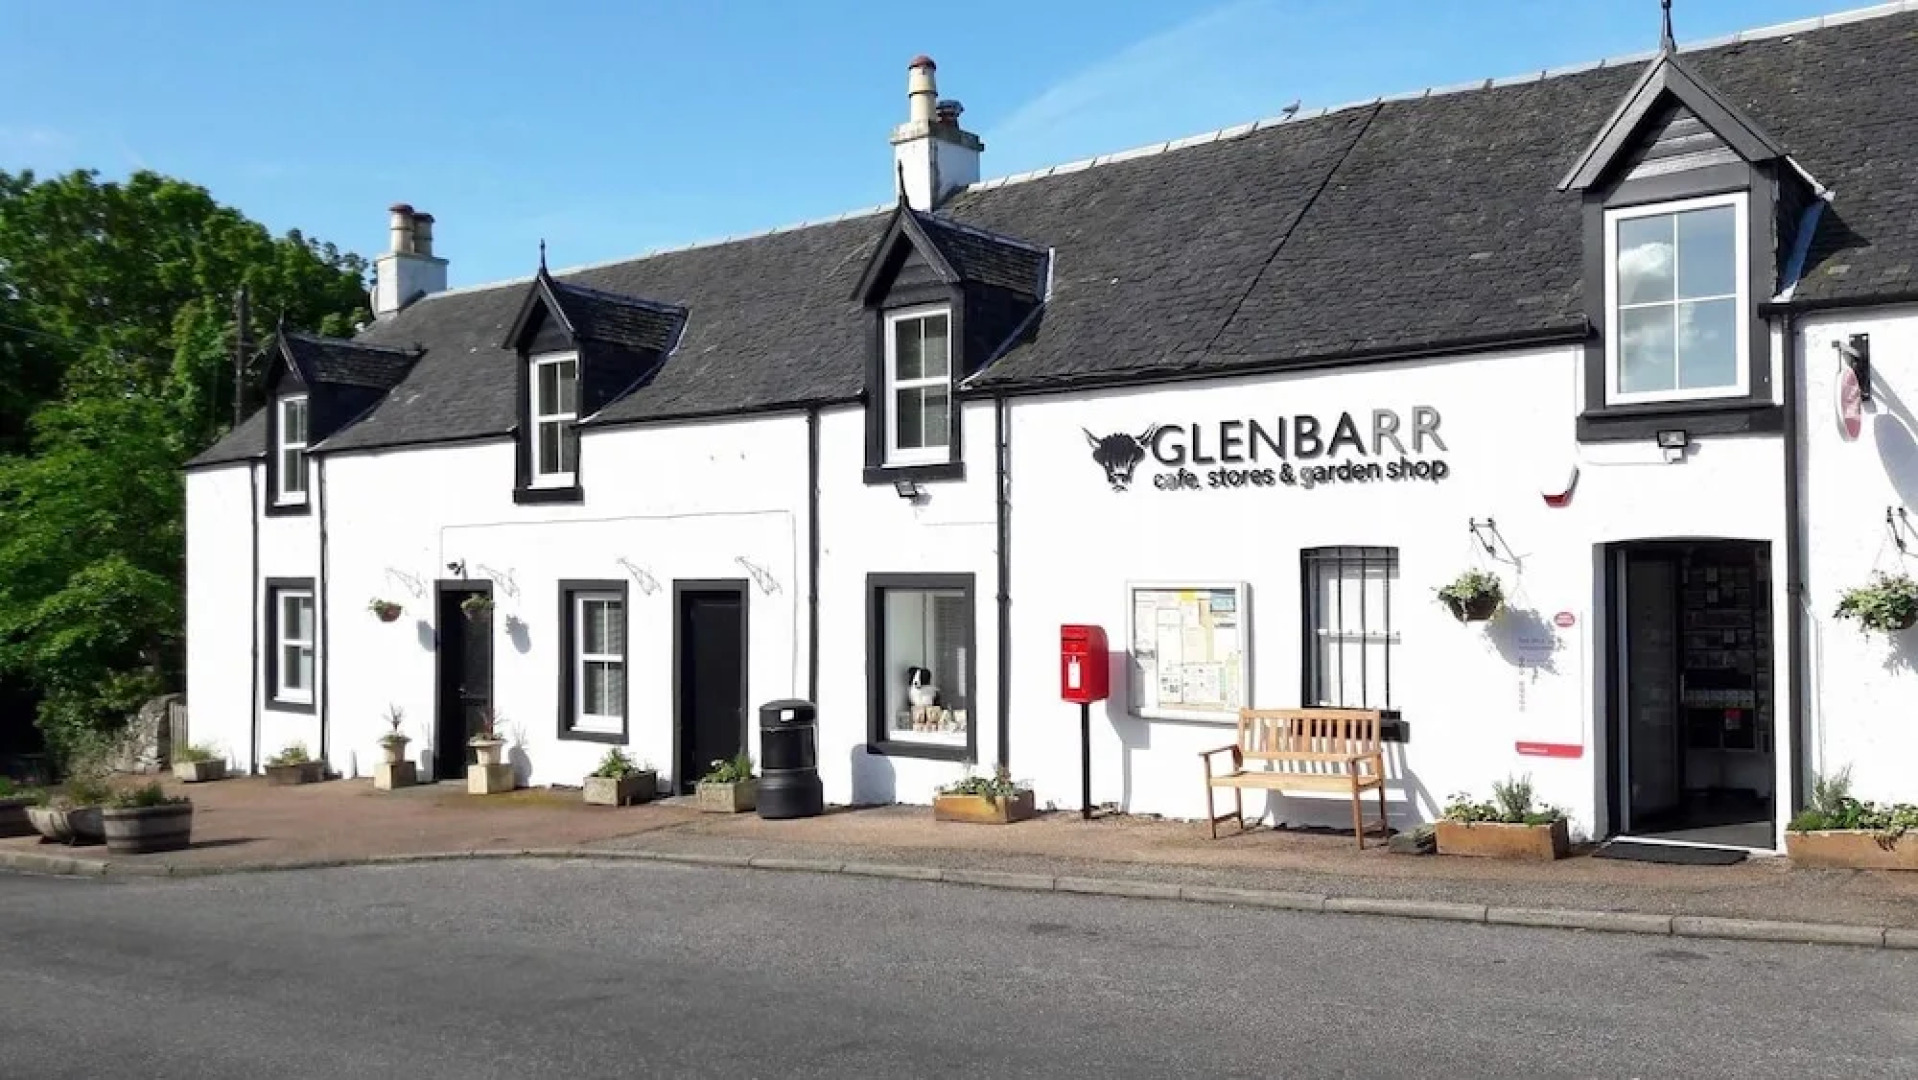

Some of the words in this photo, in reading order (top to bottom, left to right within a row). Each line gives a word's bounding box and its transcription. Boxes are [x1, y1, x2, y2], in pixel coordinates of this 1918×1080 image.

[1152, 405, 1448, 466] GLENBARR
[1207, 466, 1276, 488] stores
[1279, 462, 1297, 486] &
[1300, 458, 1383, 489] garden
[1386, 456, 1449, 484] shop
